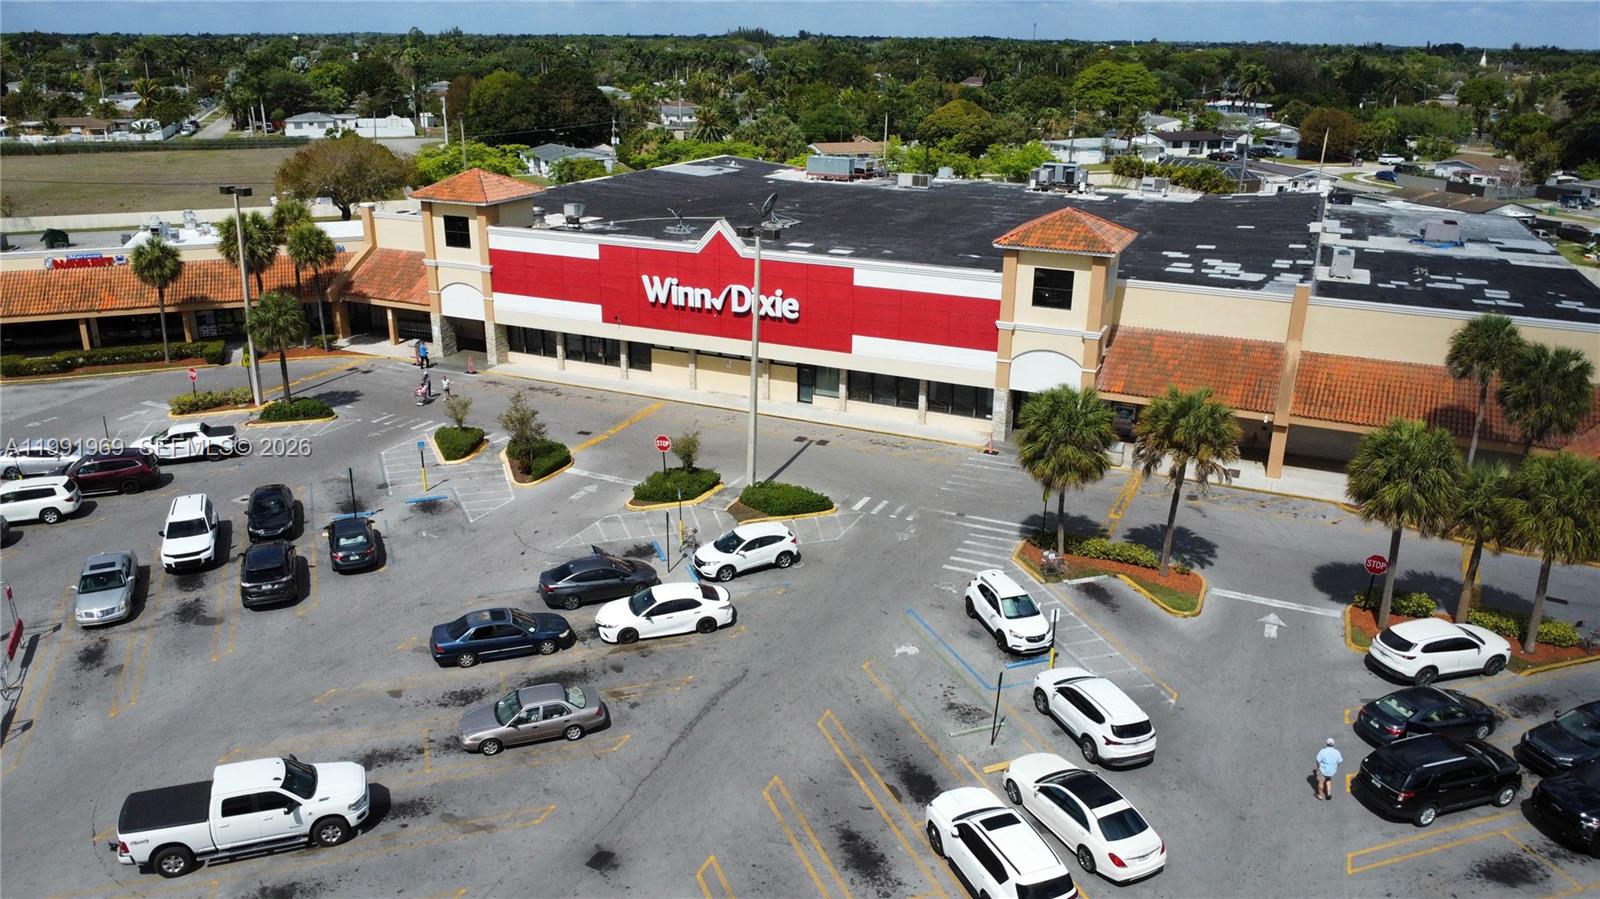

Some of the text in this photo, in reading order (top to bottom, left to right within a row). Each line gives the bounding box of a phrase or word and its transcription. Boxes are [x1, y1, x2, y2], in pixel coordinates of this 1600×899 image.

[641, 274, 712, 310] Winn
[656, 439, 670, 447] STOP
[1366, 559, 1387, 570] STOP
